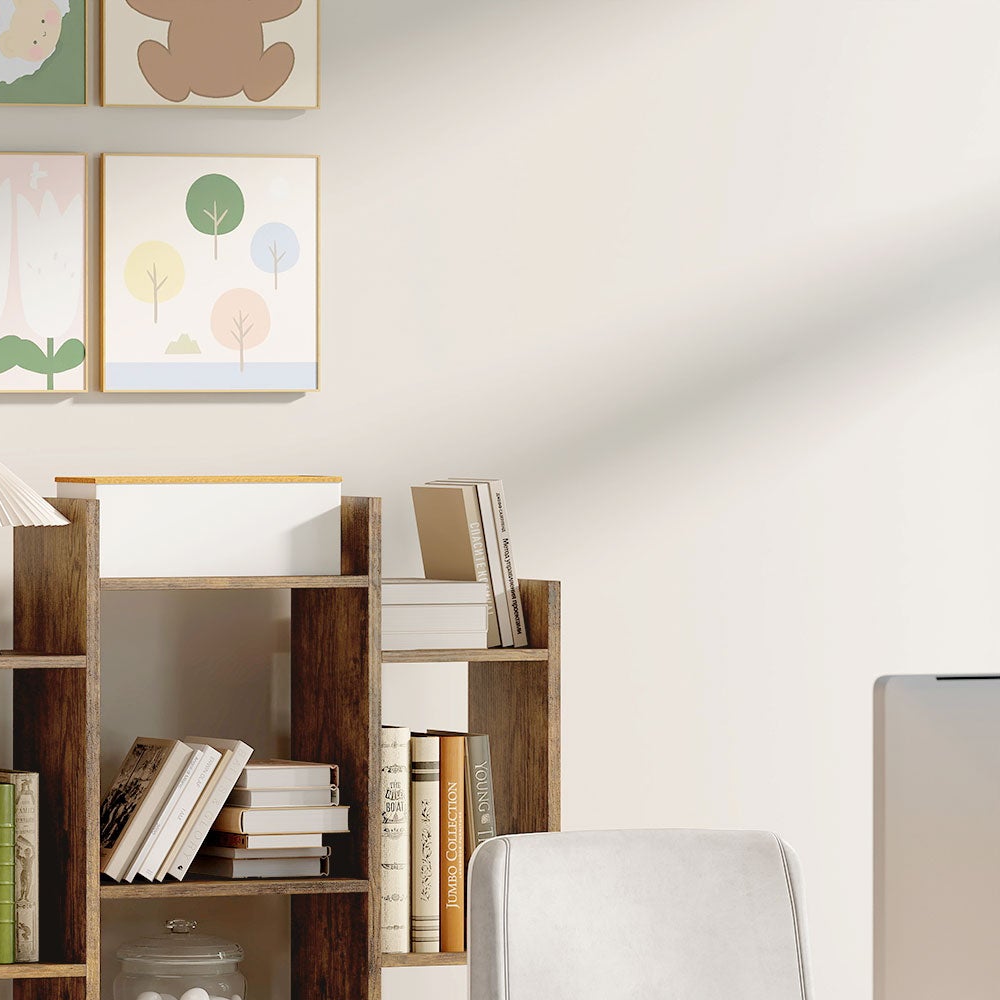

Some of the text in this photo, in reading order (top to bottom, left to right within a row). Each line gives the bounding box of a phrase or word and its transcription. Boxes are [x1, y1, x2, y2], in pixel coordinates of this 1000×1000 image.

[386, 802, 404, 812] BOAT
[474, 760, 490, 813] YOUNG
[446, 782, 459, 909] JUMBO COLLECTION
